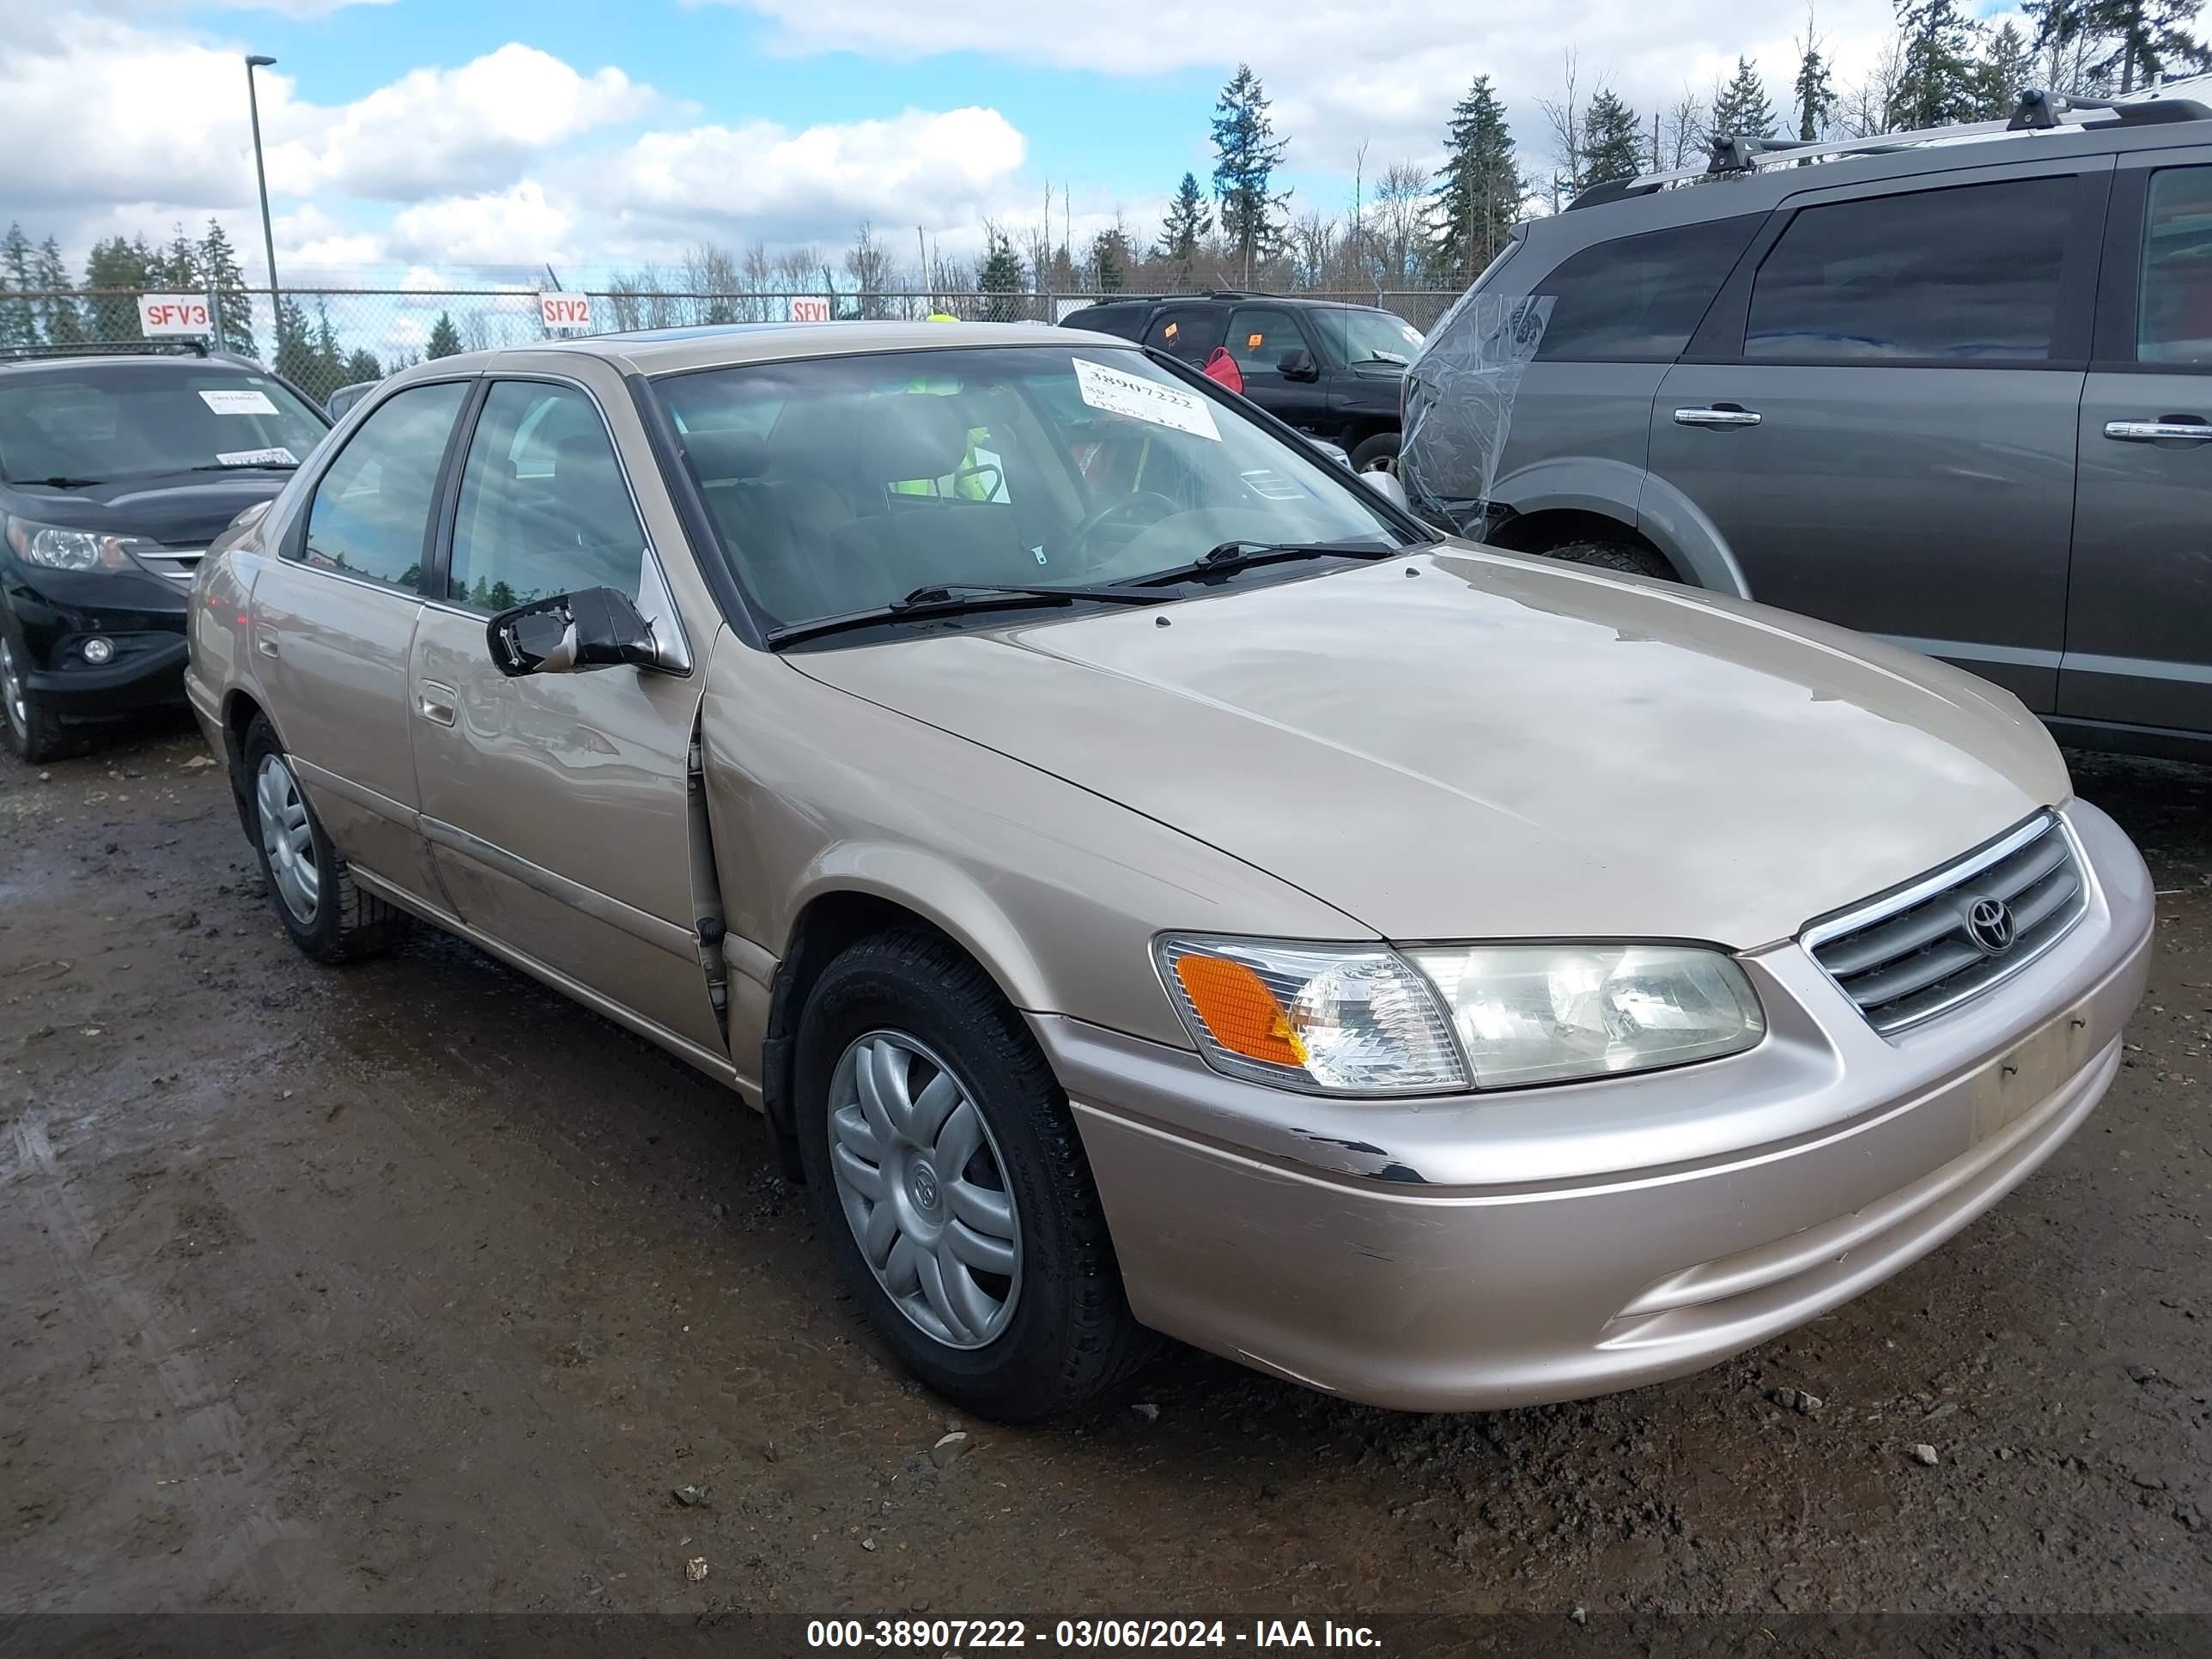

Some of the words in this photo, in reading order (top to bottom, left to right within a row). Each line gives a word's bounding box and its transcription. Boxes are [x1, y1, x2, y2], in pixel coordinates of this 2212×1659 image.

[148, 305, 207, 325] SFV3
[544, 301, 589, 322] SFV2
[793, 301, 828, 322] SFV1
[1090, 371, 1194, 410] 38907222
